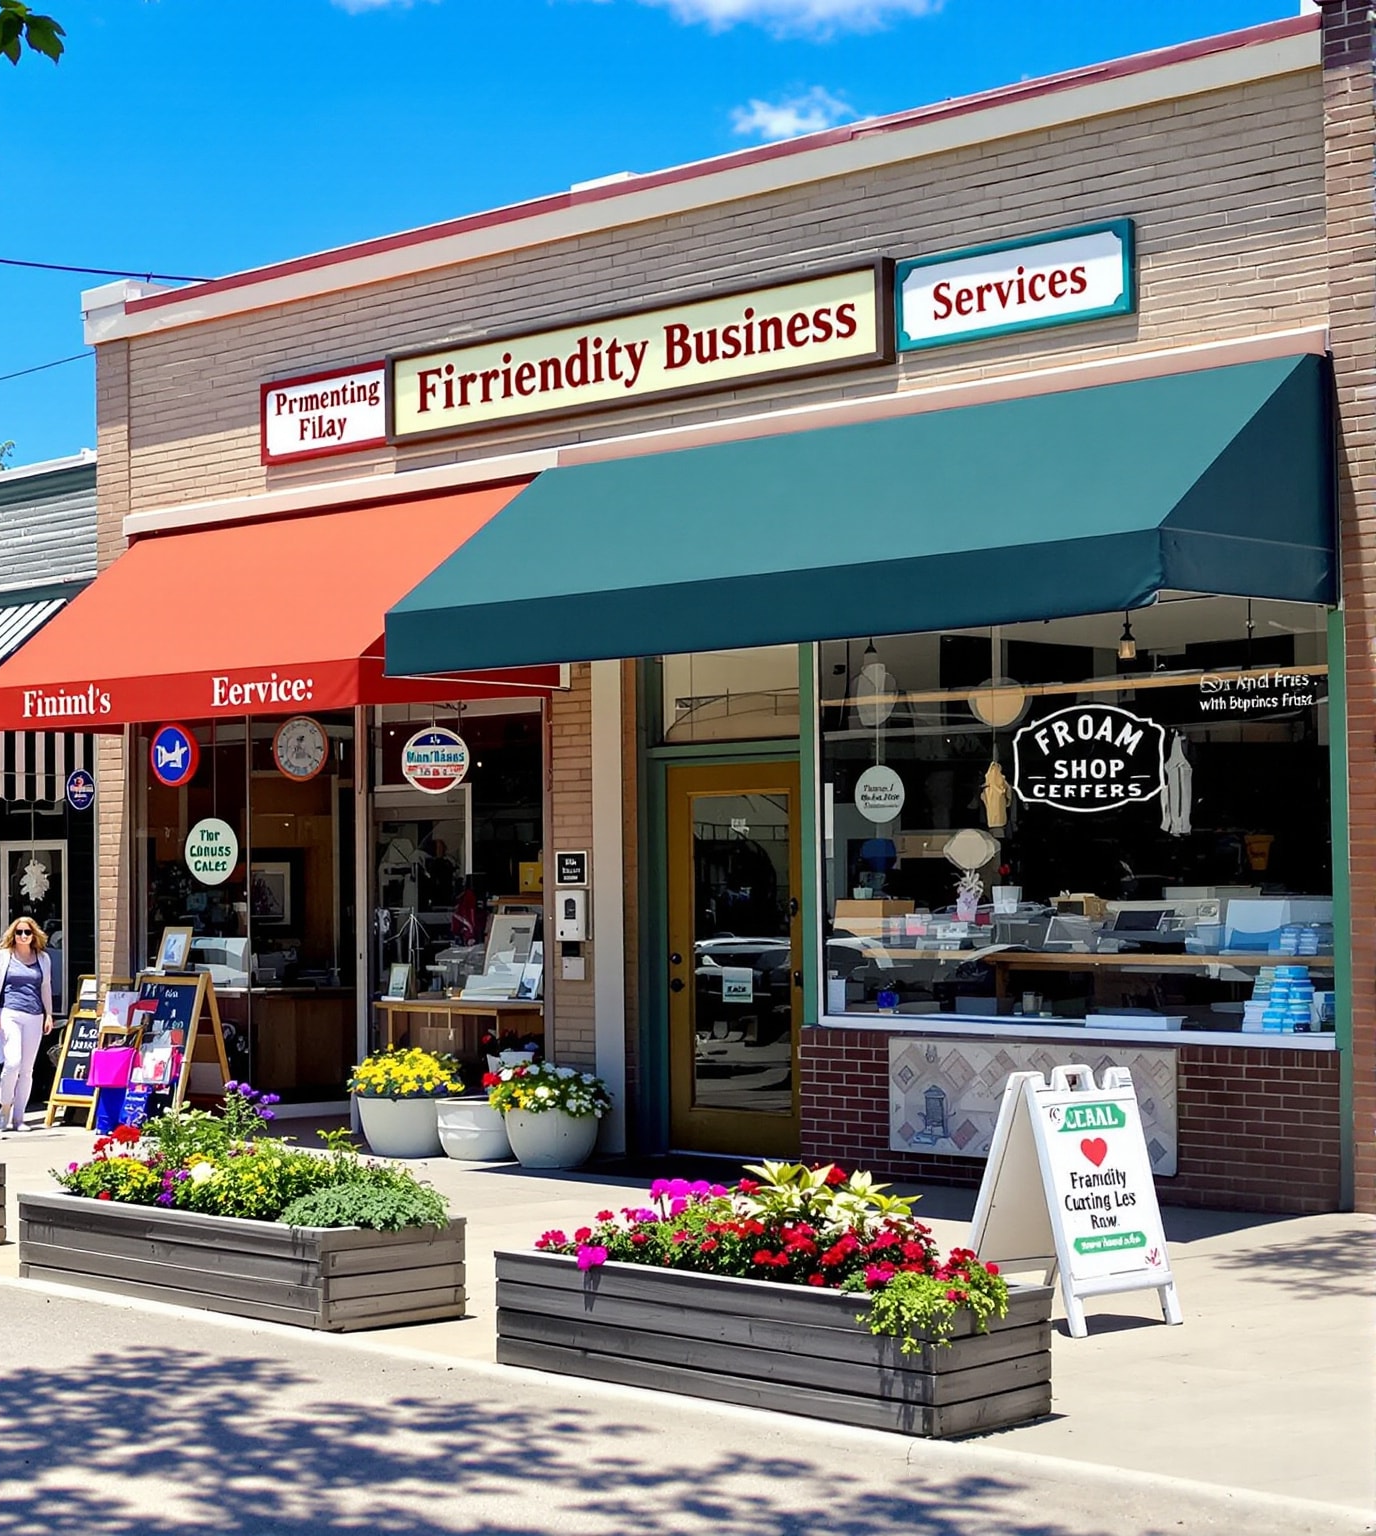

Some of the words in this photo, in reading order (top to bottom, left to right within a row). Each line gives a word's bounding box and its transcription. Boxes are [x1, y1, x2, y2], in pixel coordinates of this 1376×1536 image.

[932, 265, 1088, 321] Services
[416, 335, 650, 414] Firriendity
[662, 301, 858, 371] Business
[1034, 714, 1144, 756] FROAM
[1054, 759, 1125, 780] SHOP
